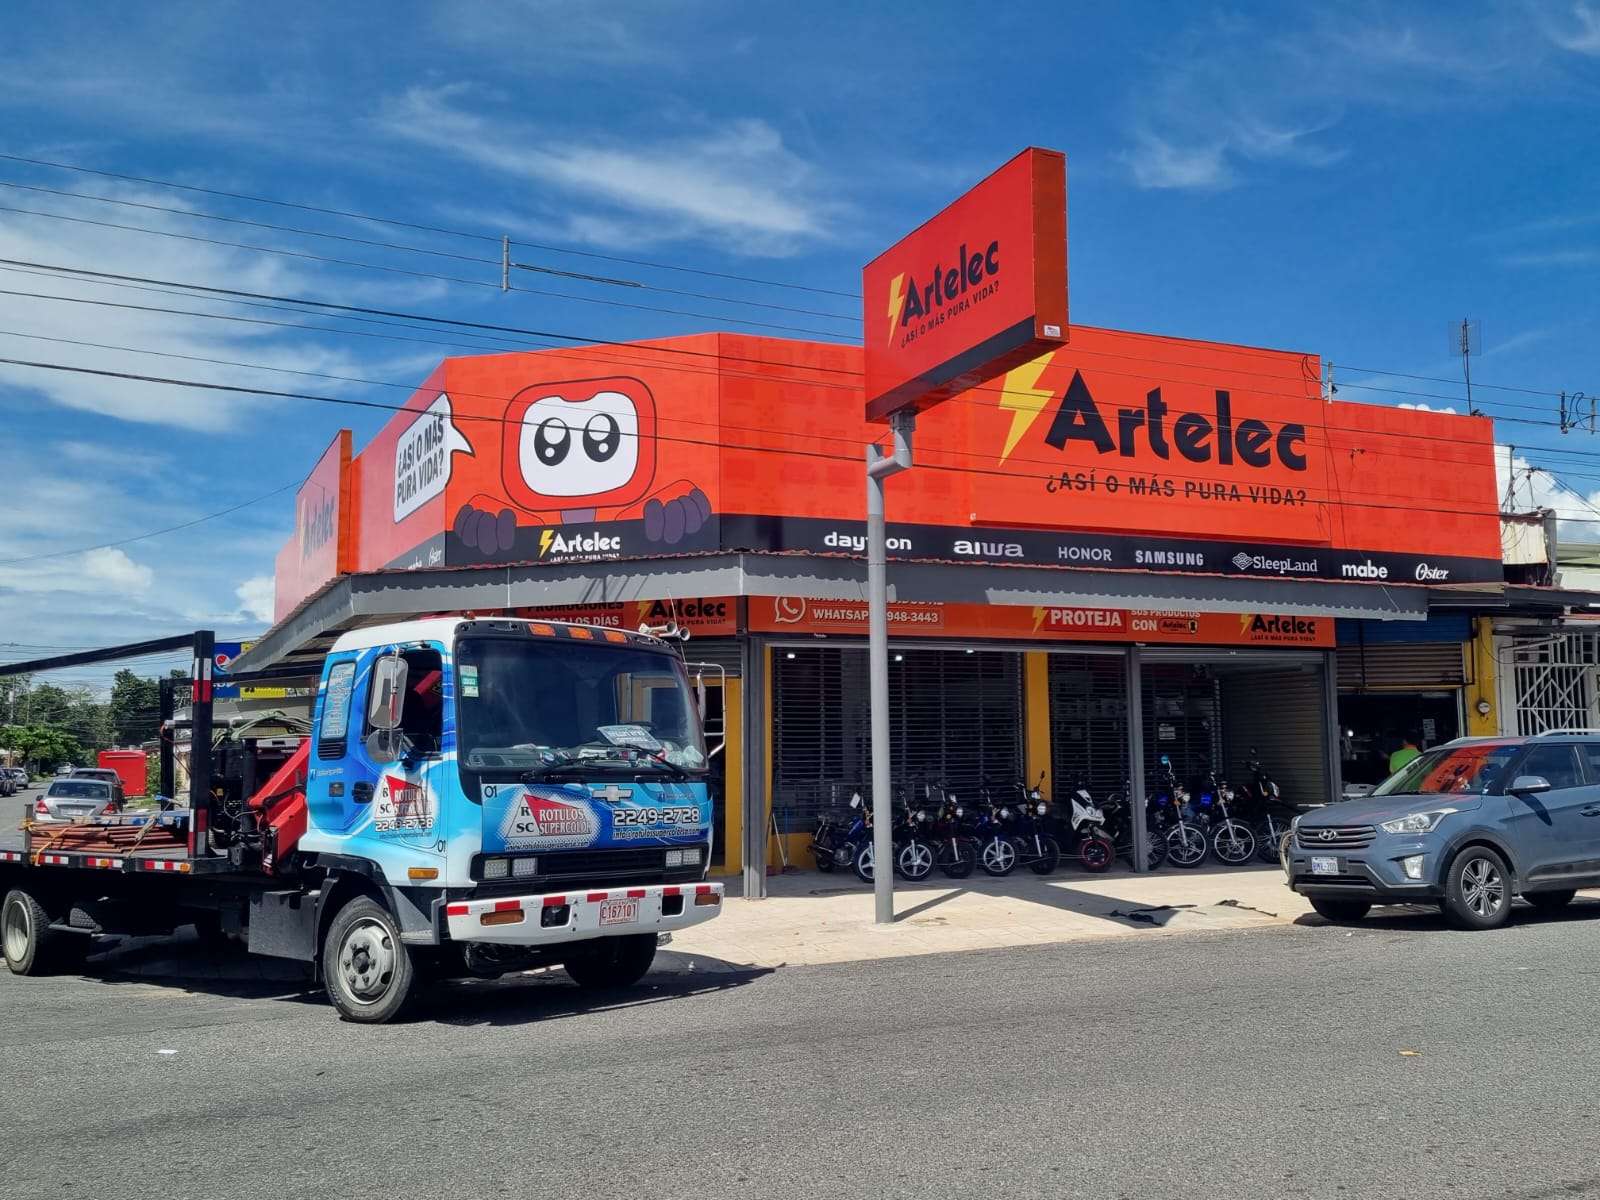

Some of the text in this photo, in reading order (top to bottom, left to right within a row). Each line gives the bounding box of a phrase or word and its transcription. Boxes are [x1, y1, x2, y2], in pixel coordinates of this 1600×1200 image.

[901, 241, 999, 327] Artelec
[947, 298, 970, 319] PURA
[973, 280, 999, 304] VIDA?
[1045, 368, 1308, 472] Artelec
[397, 431, 415, 479] ¿ASÍ
[416, 433, 423, 462] O
[396, 448, 444, 508] PURA VIDA?
[1046, 469, 1307, 507] ¿ASÍ O MÁS PURA VIDA?
[550, 531, 621, 553] Artelec
[824, 531, 912, 551] dayon
[953, 540, 1024, 557] aiwa
[1058, 547, 1112, 561] HONOR
[1135, 550, 1204, 565] SAMSUNG
[1253, 556, 1318, 574] SleepLand
[1342, 559, 1388, 578] mabe
[1415, 563, 1449, 580] Oster
[649, 598, 726, 618] Artelec
[813, 608, 938, 623] WHATSAP 948-3443
[593, 613, 620, 626] DÍAS
[1051, 609, 1122, 627] PROTEJA
[1132, 619, 1158, 631] CON
[1250, 614, 1316, 634] Artelec
[521, 807, 531, 816] R
[540, 808, 584, 821] ROTULOS
[613, 807, 700, 826] 2249-2728
[516, 822, 534, 833] SC
[540, 821, 592, 834] SUPERCOLOR
